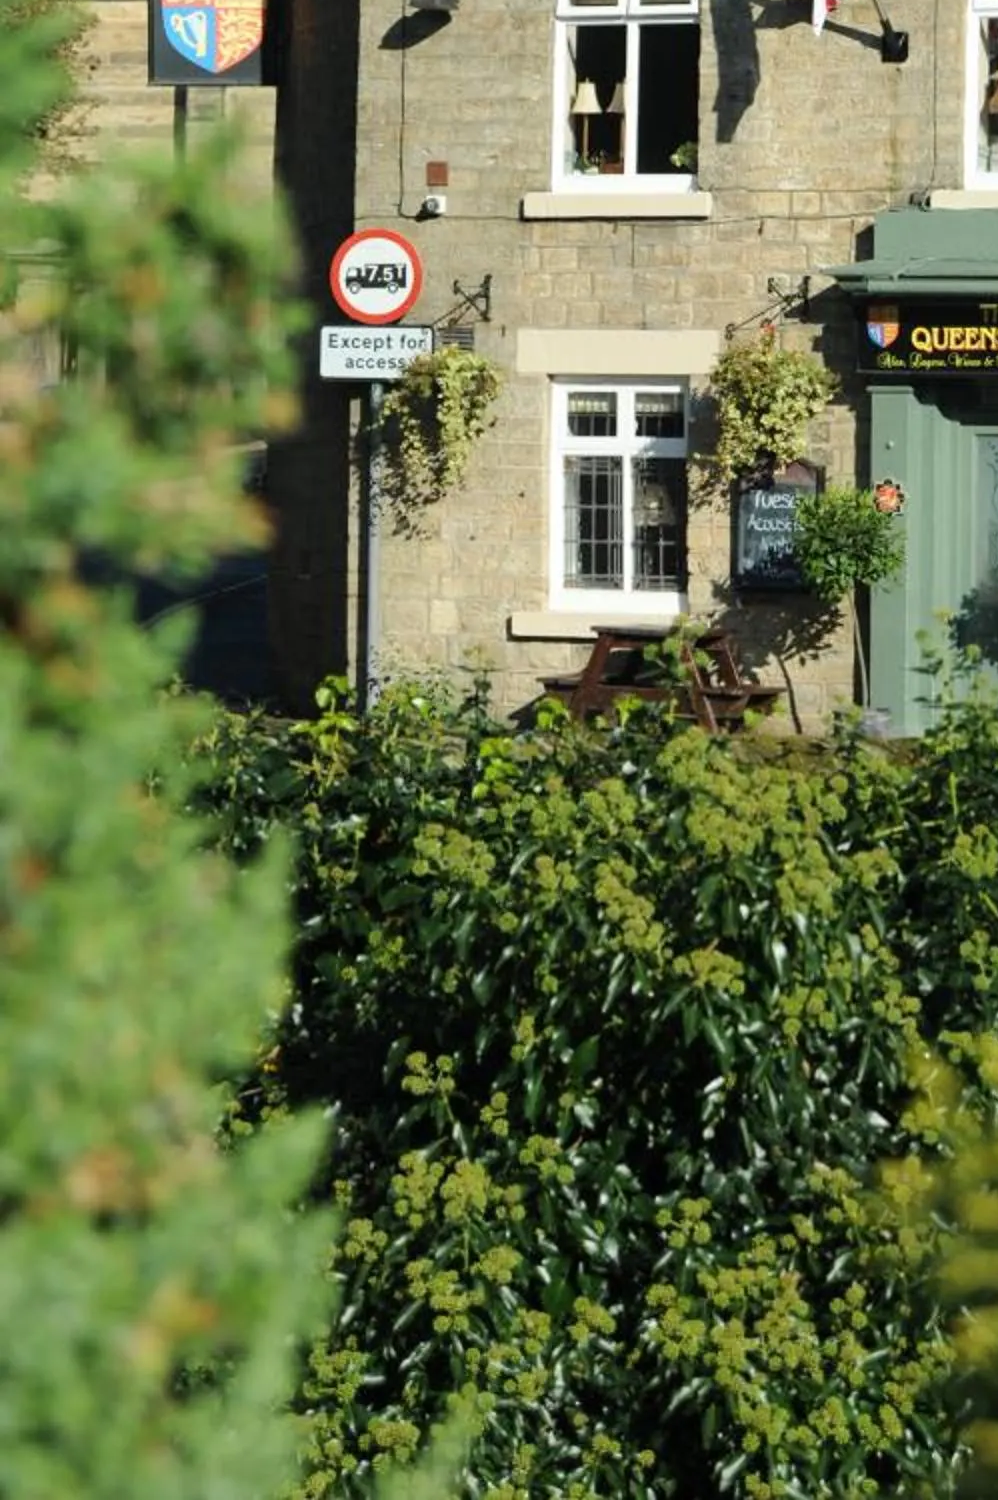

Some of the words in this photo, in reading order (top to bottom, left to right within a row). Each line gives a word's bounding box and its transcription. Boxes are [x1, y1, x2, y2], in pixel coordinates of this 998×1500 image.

[328, 333, 392, 352] Except
[400, 334, 426, 349] for
[345, 357, 406, 369] access
